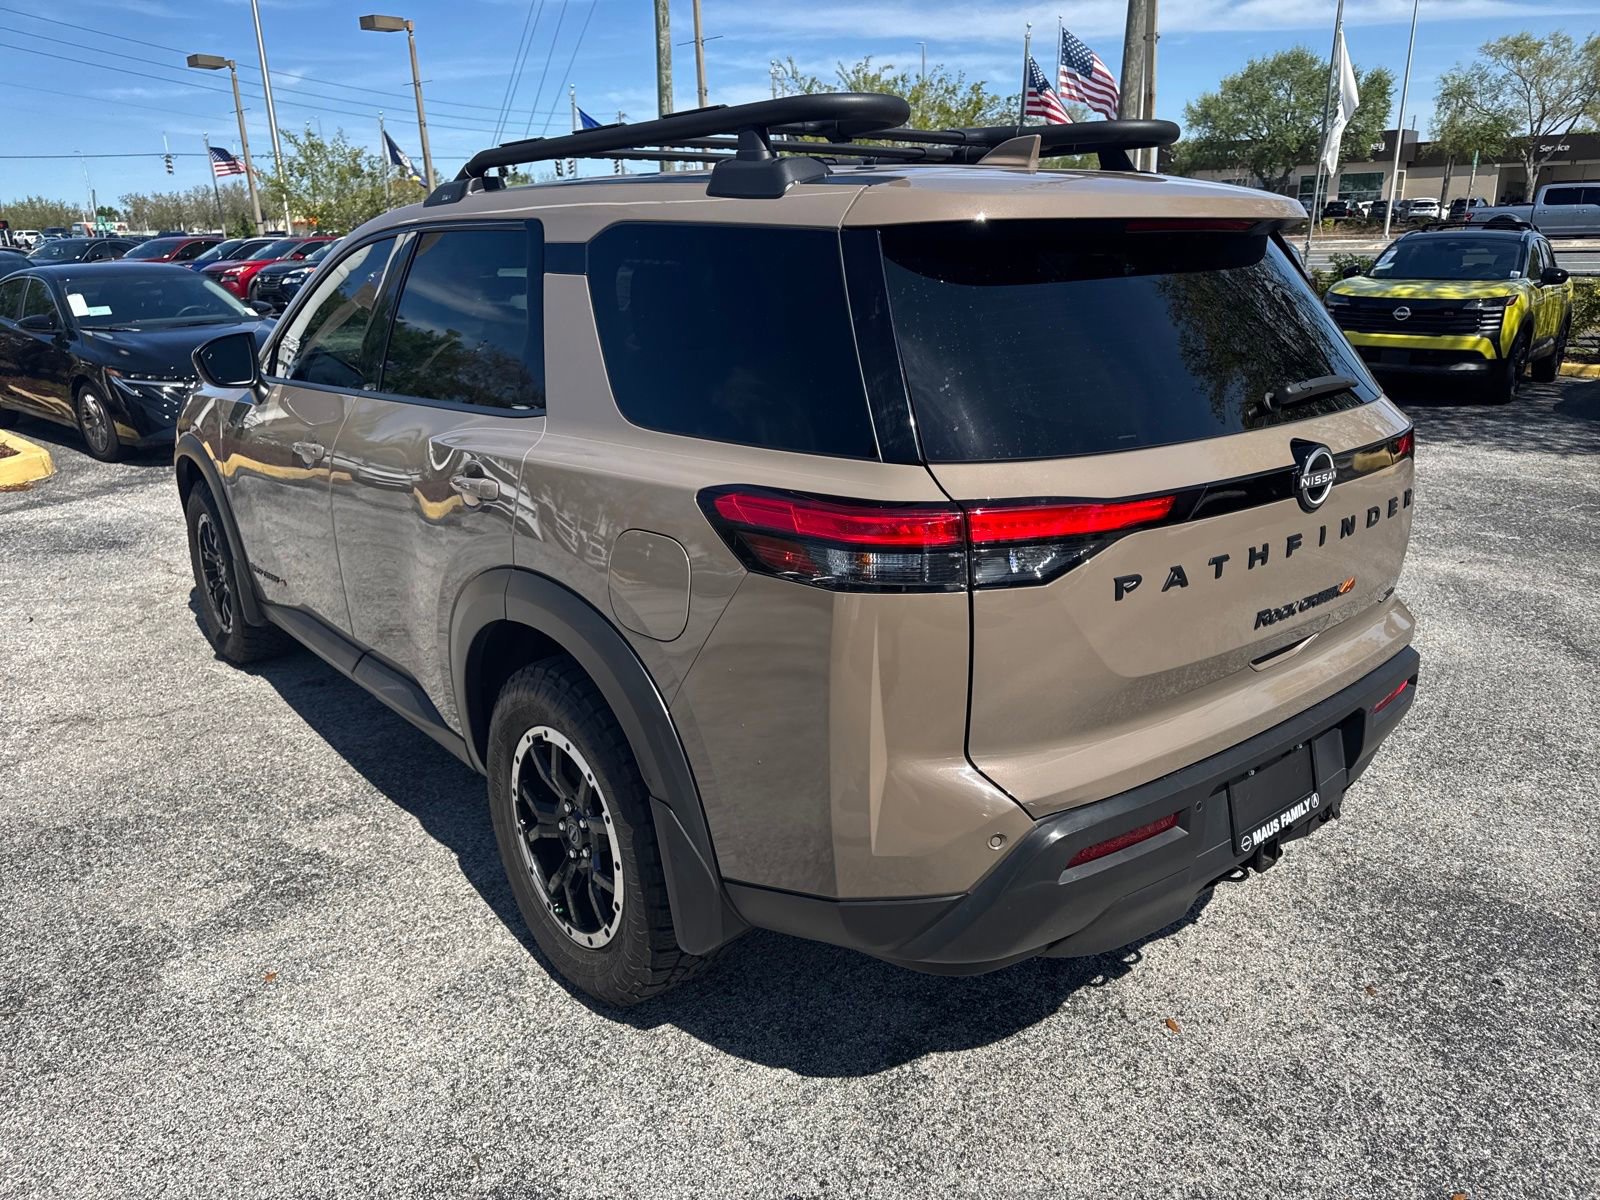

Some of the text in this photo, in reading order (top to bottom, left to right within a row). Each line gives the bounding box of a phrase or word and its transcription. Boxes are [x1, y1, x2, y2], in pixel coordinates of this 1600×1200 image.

[1301, 470, 1337, 487] NISSAN
[1113, 488, 1412, 601] PATHFINDER
[1252, 798, 1311, 845] MAUS FAMILY
